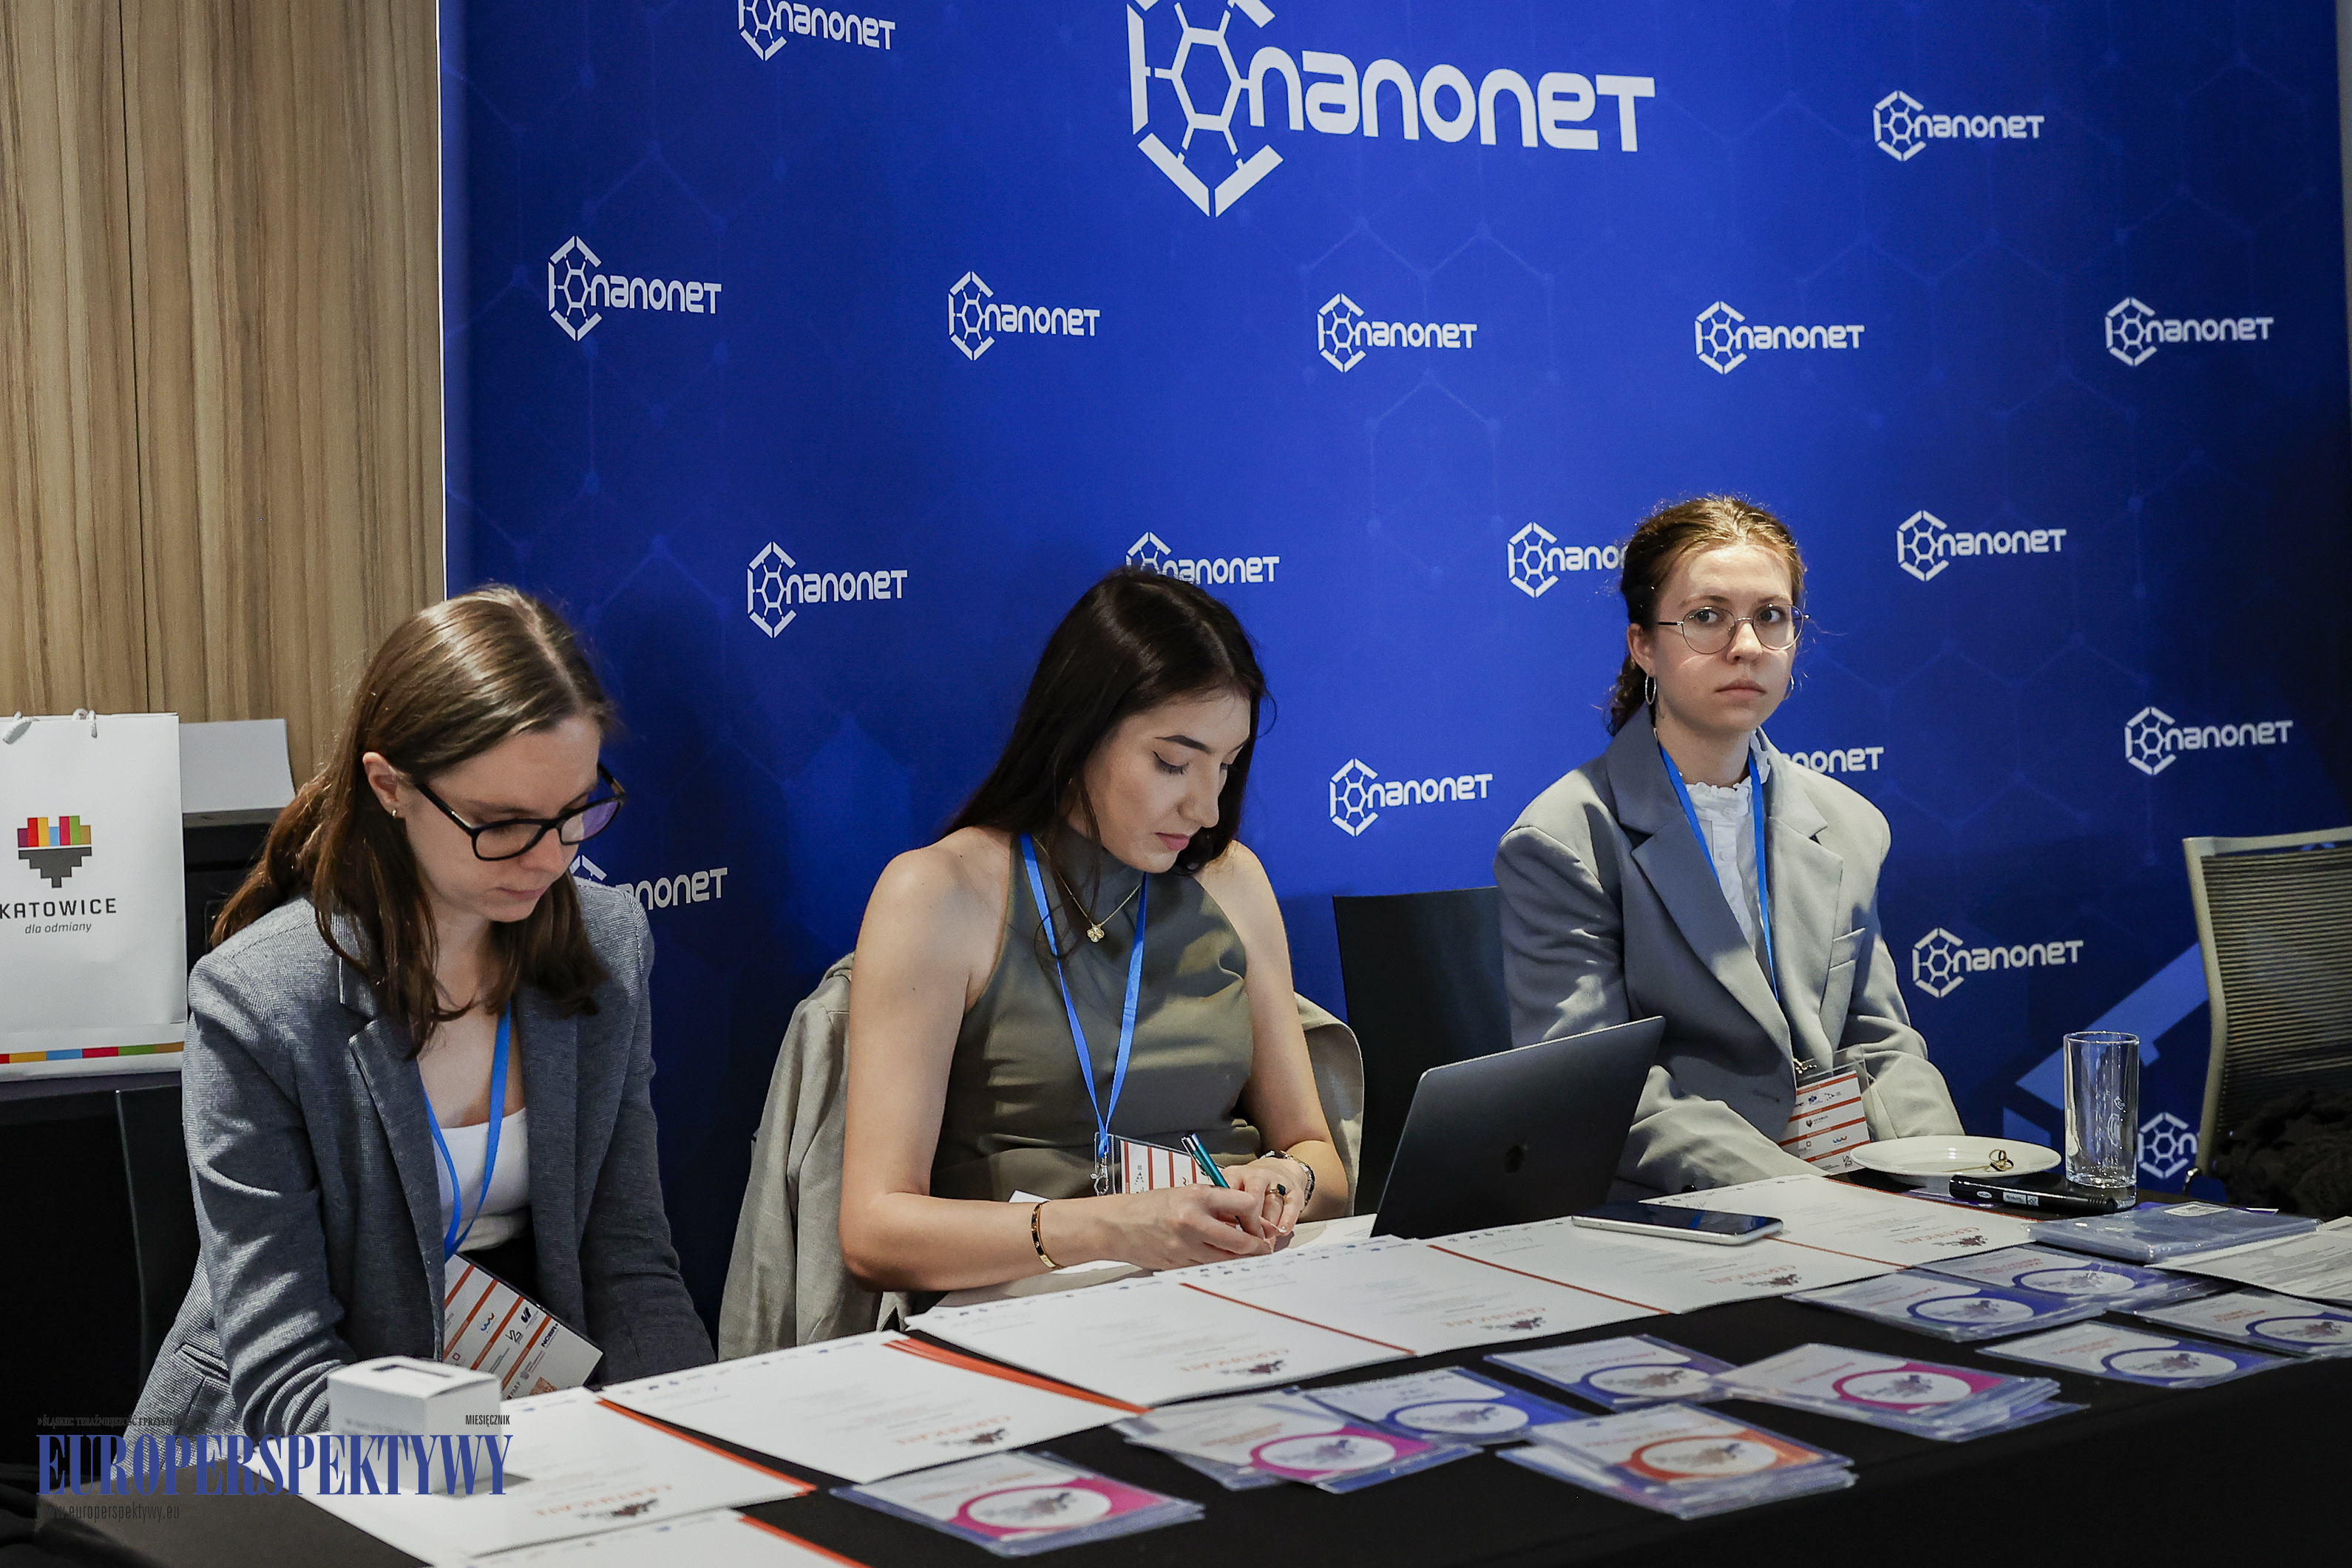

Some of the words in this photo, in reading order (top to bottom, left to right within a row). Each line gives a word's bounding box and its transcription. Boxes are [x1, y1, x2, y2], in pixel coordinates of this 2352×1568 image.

[0, 897, 117, 920] KATOWICE
[24, 923, 42, 934] dla
[44, 921, 92, 934] odmiany
